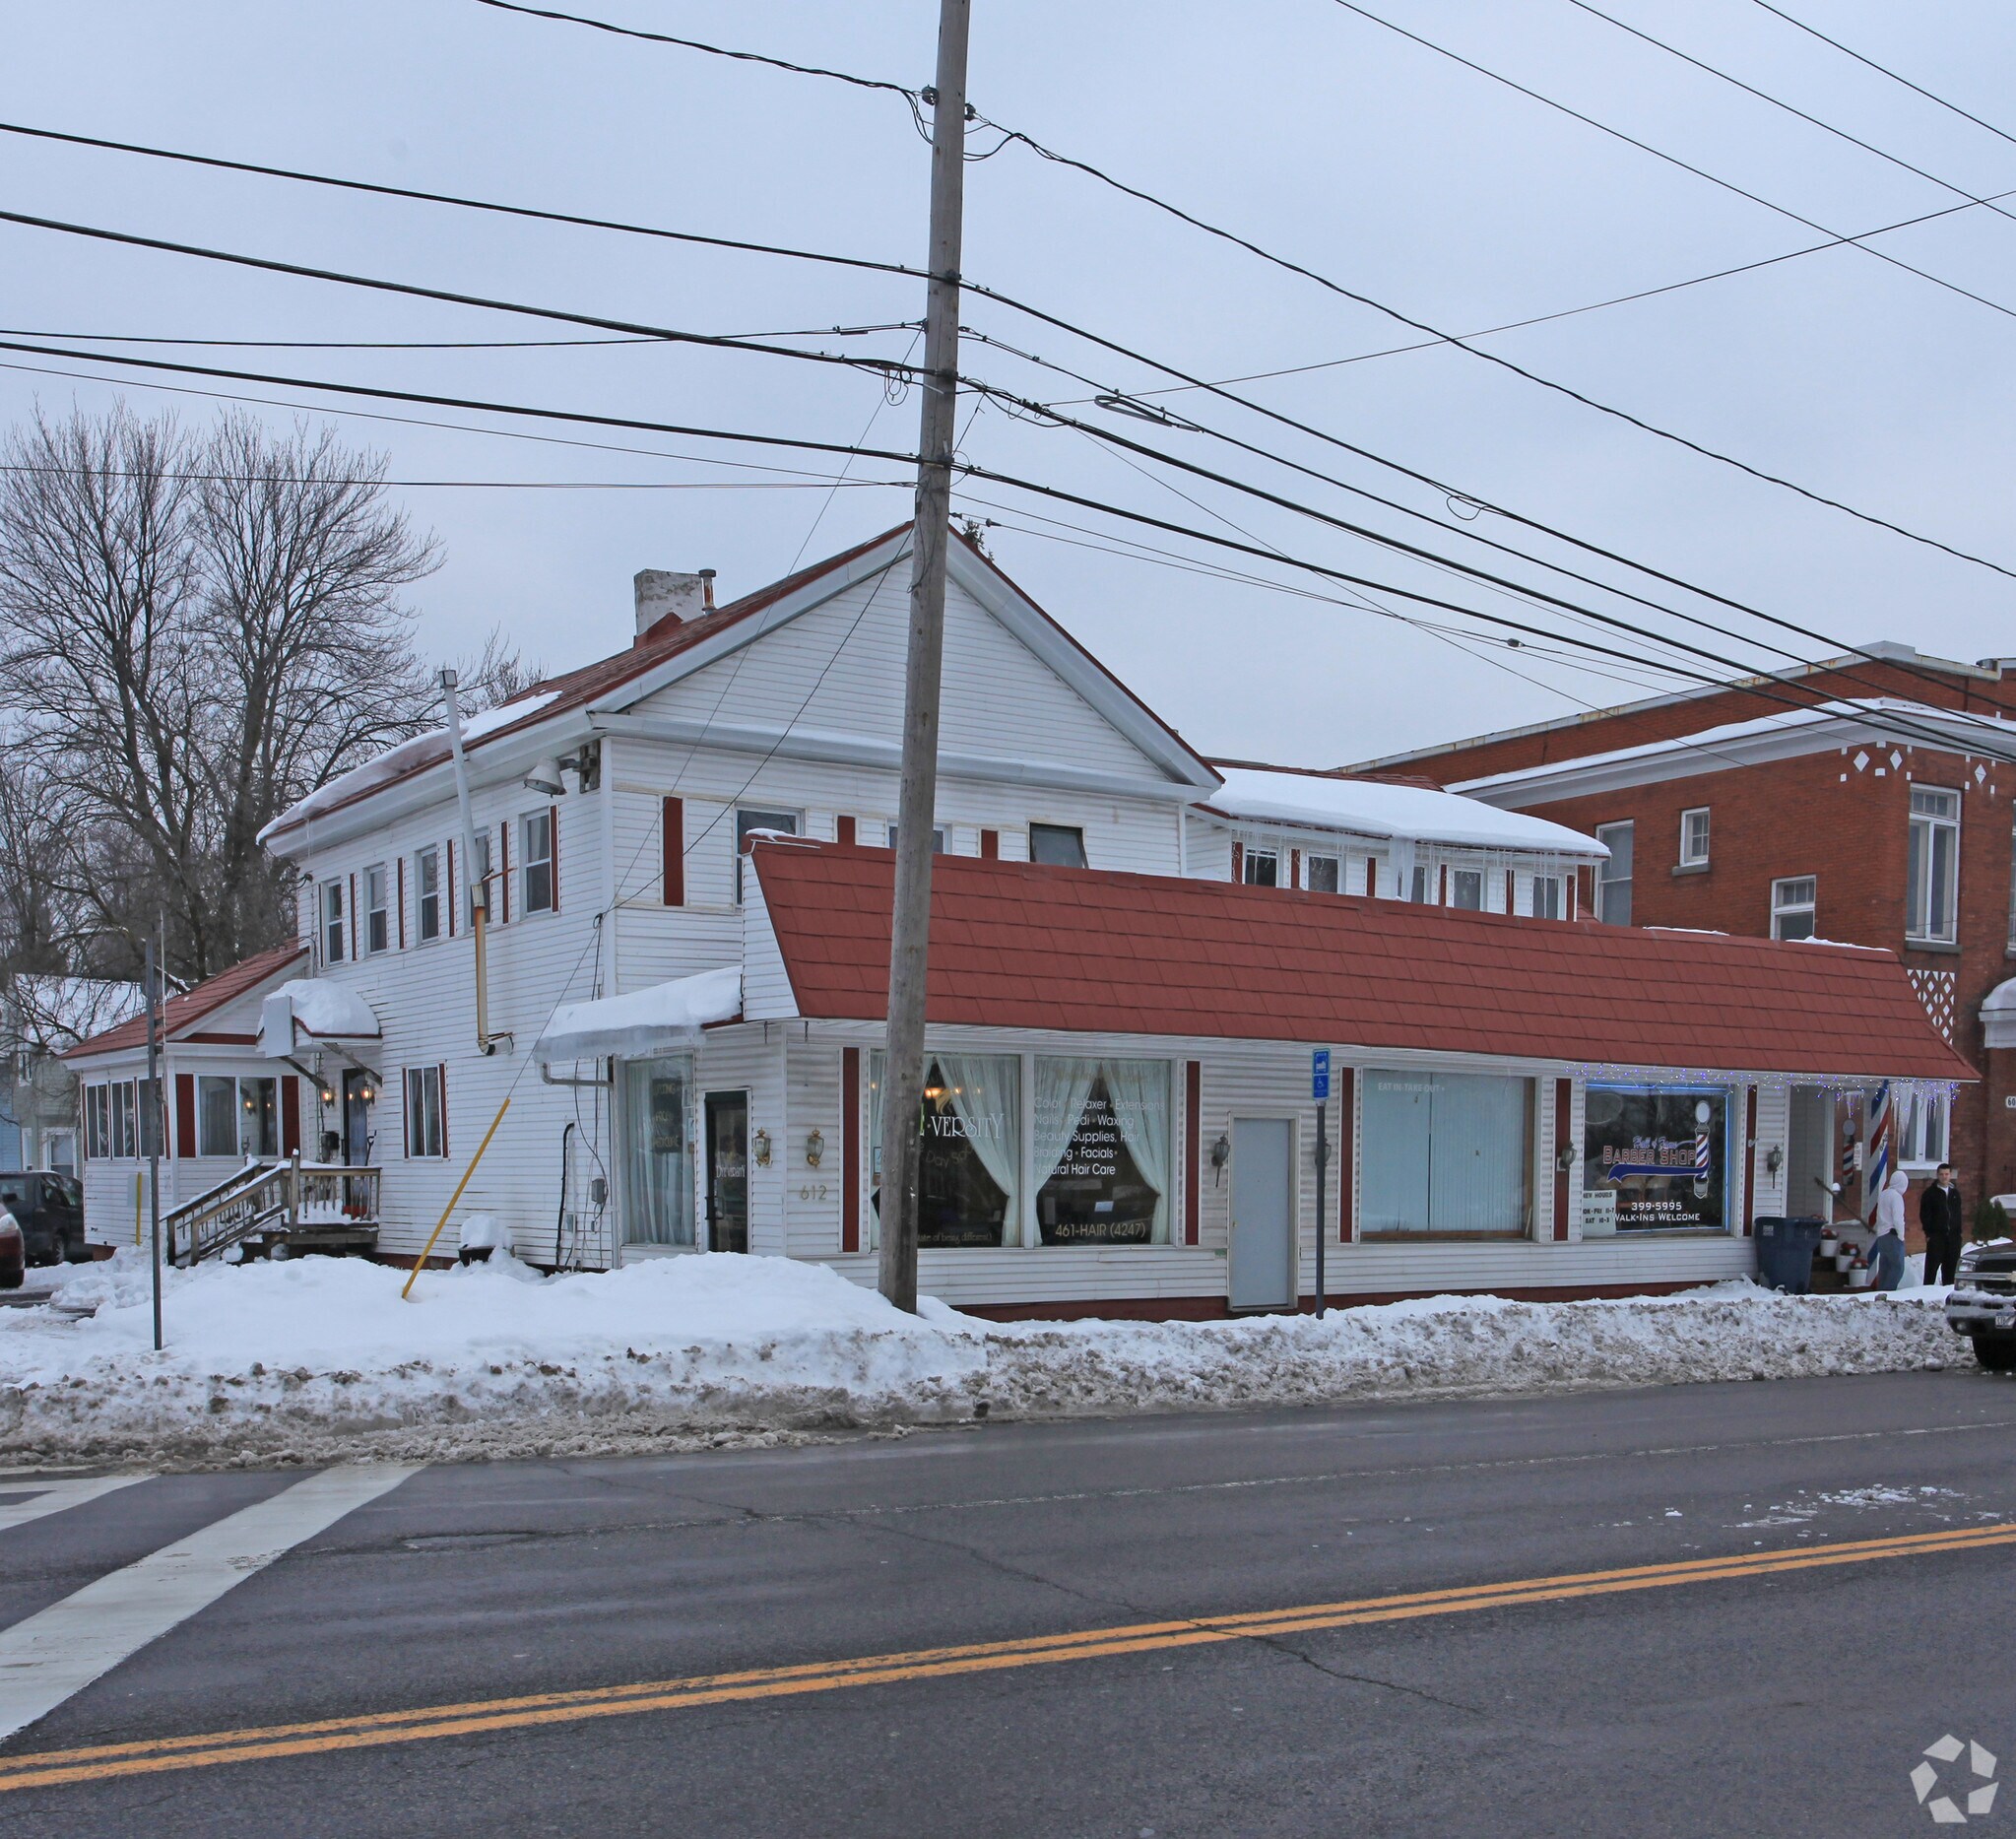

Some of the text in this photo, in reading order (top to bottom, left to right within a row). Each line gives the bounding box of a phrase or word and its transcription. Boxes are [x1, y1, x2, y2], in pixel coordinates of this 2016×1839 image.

[1034, 1097, 1165, 1110] Color Relaxer Extensions
[1034, 1114, 1134, 1129] Nails Pedi Waxing
[1034, 1130, 1139, 1144] Beauty Supplies, Hair
[1034, 1147, 1114, 1160] Braiding Facials
[1034, 1163, 1116, 1174] Natural Hair Care
[800, 1185, 827, 1201] 612
[1055, 1222, 1146, 1238] 461-HAIR (4247)
